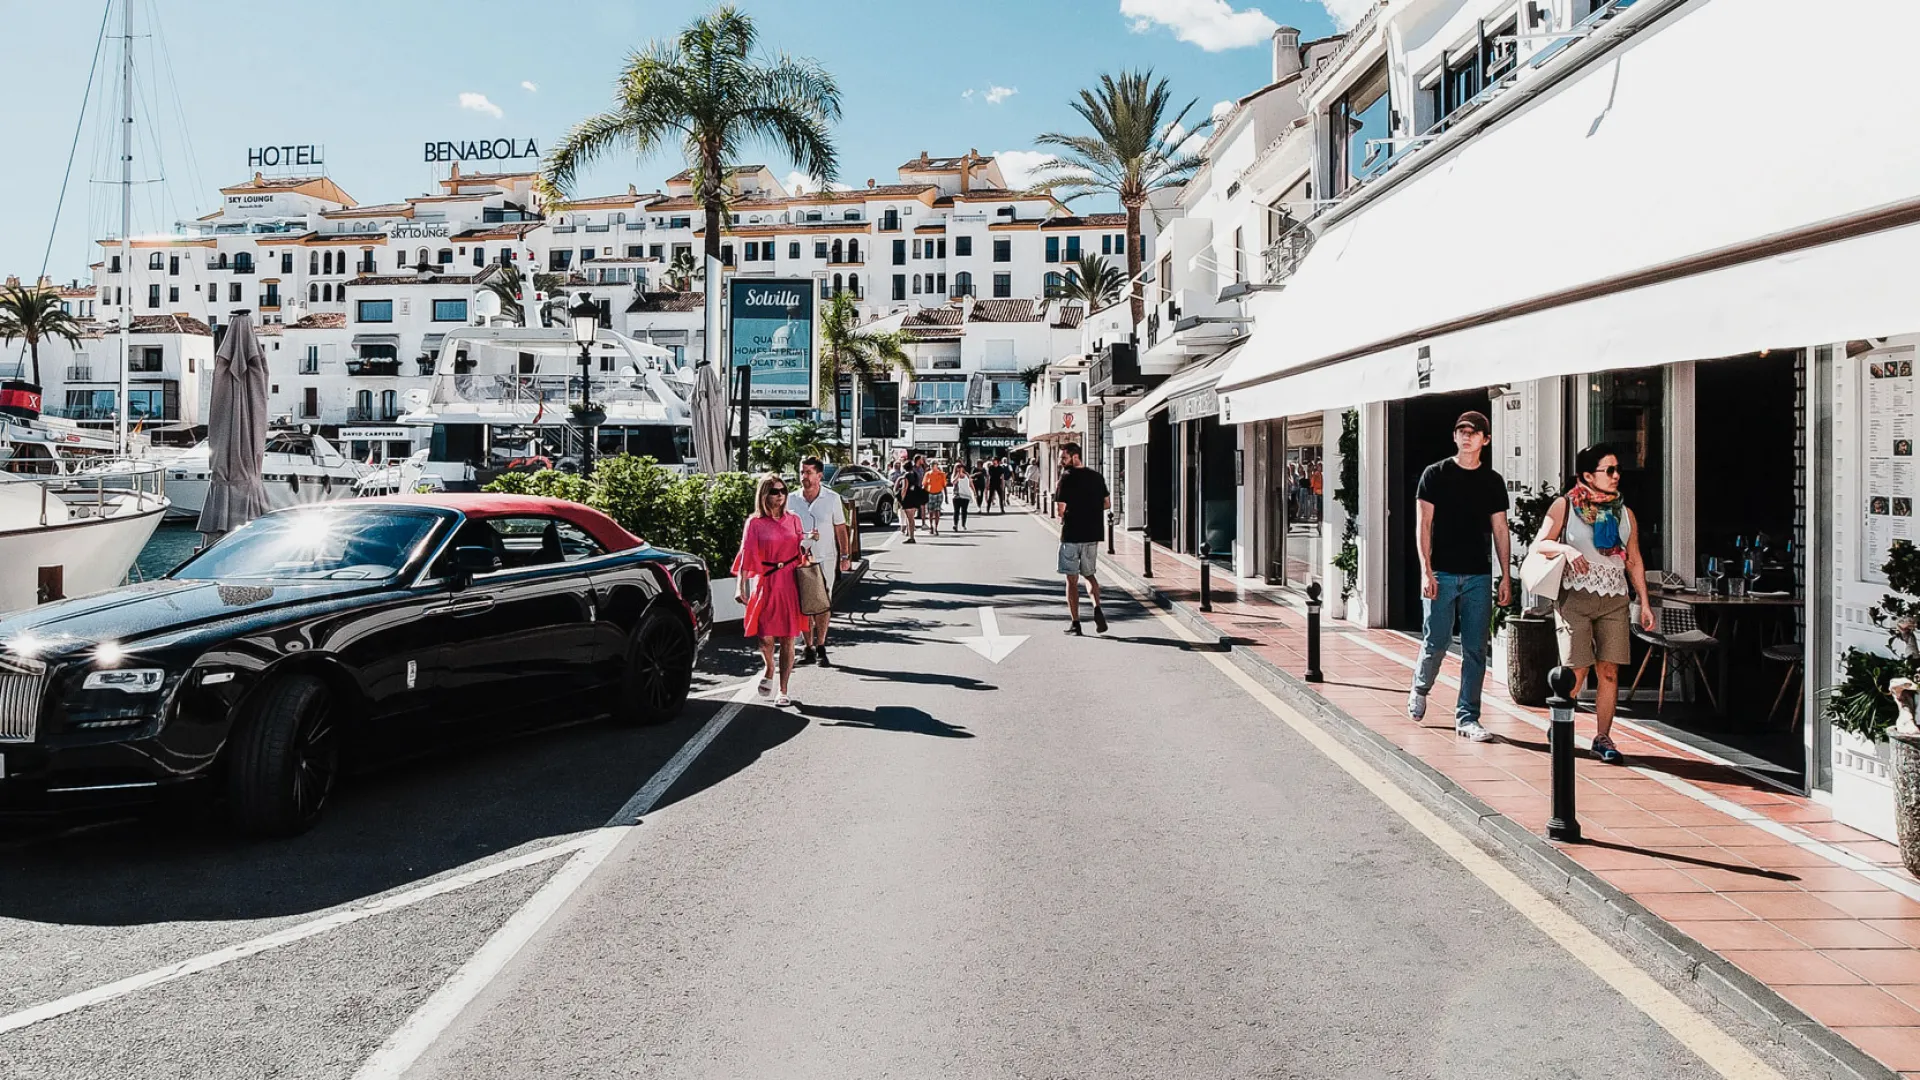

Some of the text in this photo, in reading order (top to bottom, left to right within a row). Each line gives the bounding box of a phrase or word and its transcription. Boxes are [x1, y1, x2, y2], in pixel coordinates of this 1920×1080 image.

[248, 144, 323, 167] HOTEL
[424, 138, 540, 162] BENABOLA
[244, 195, 274, 203] LOUNGE
[390, 227, 449, 239] SKY LOUNGE
[745, 288, 801, 306] Solvilla
[753, 336, 791, 345] QUALITY
[734, 346, 809, 356] HOMES IN PRIME
[746, 359, 797, 367] LOCATIONS
[28, 395, 38, 408] X
